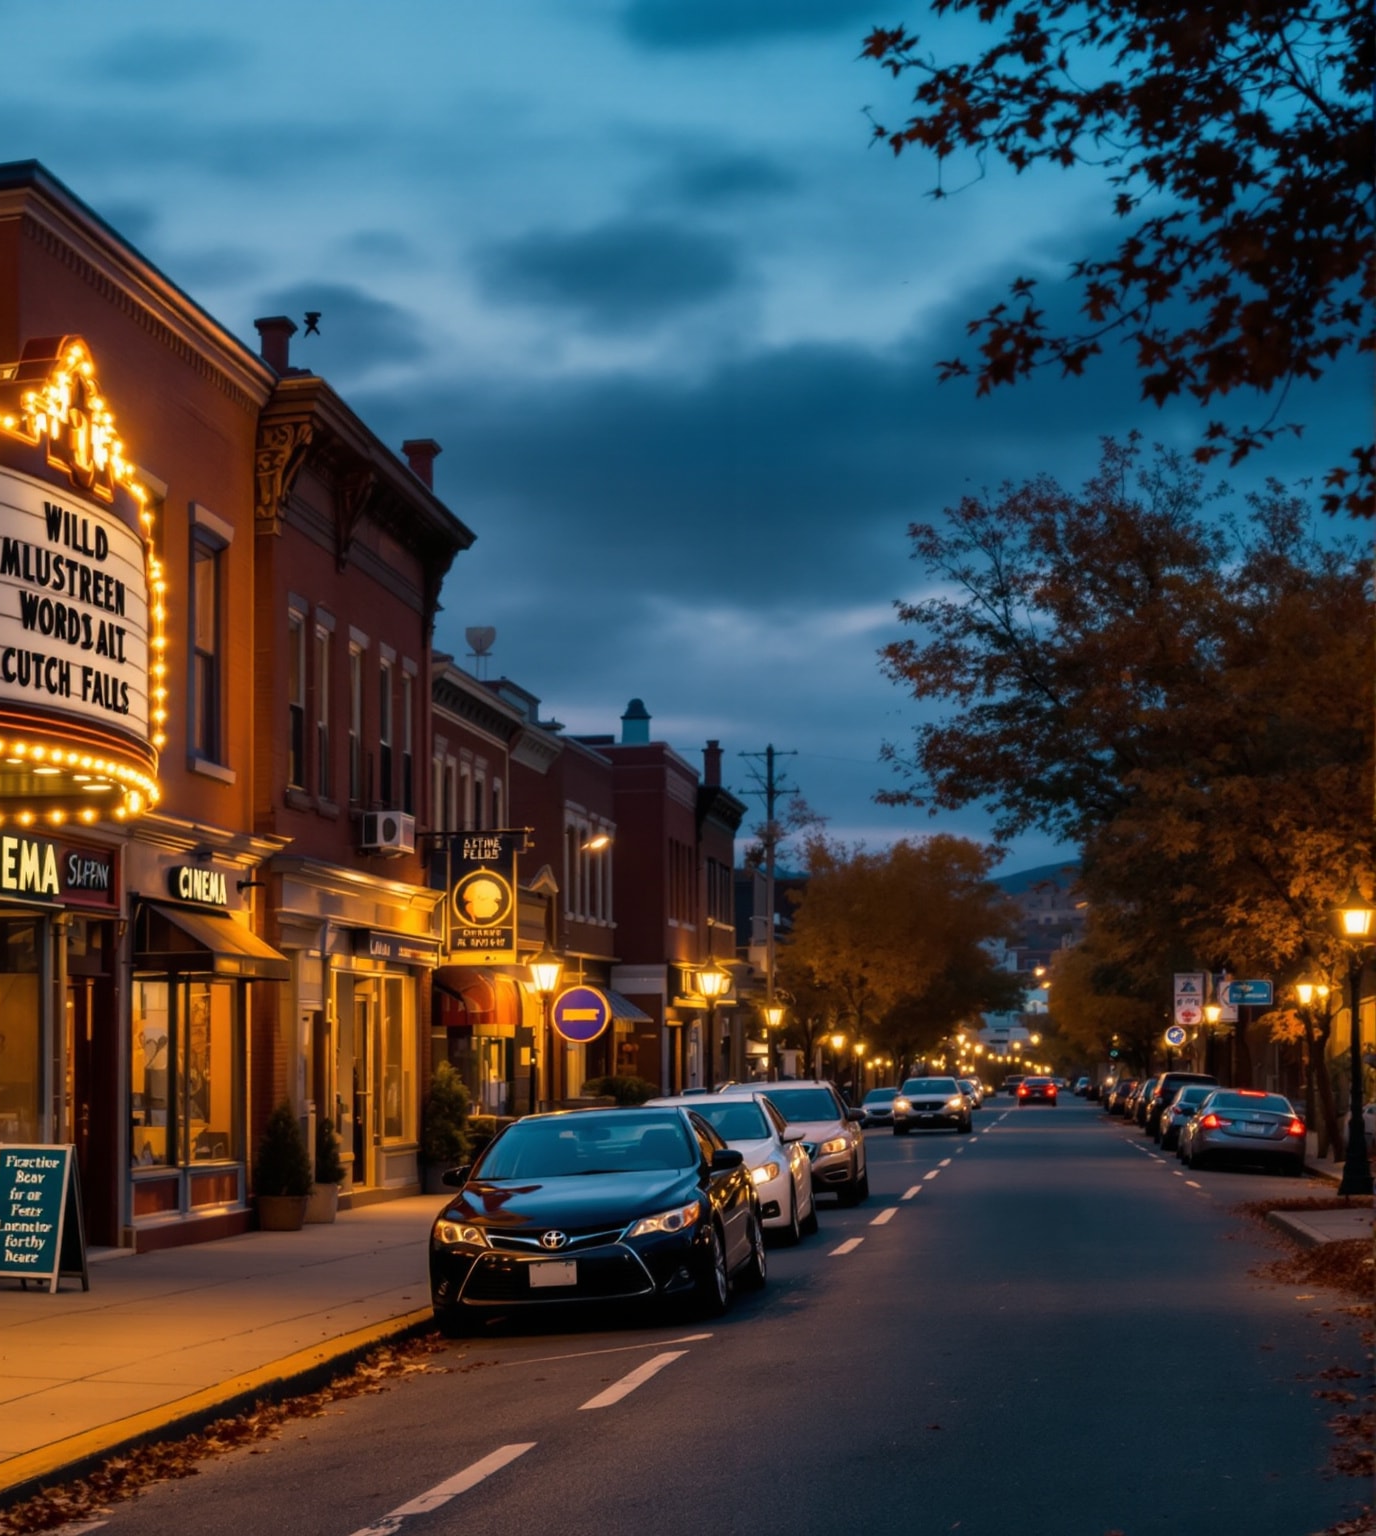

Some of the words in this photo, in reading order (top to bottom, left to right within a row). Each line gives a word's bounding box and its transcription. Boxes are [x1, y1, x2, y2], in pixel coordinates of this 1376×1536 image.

[44, 501, 109, 562] WILLD
[0, 537, 125, 617] MLUSTREEN
[2, 647, 71, 698] CUTCH
[82, 666, 130, 715] FALLS
[179, 866, 228, 905] CINEMA
